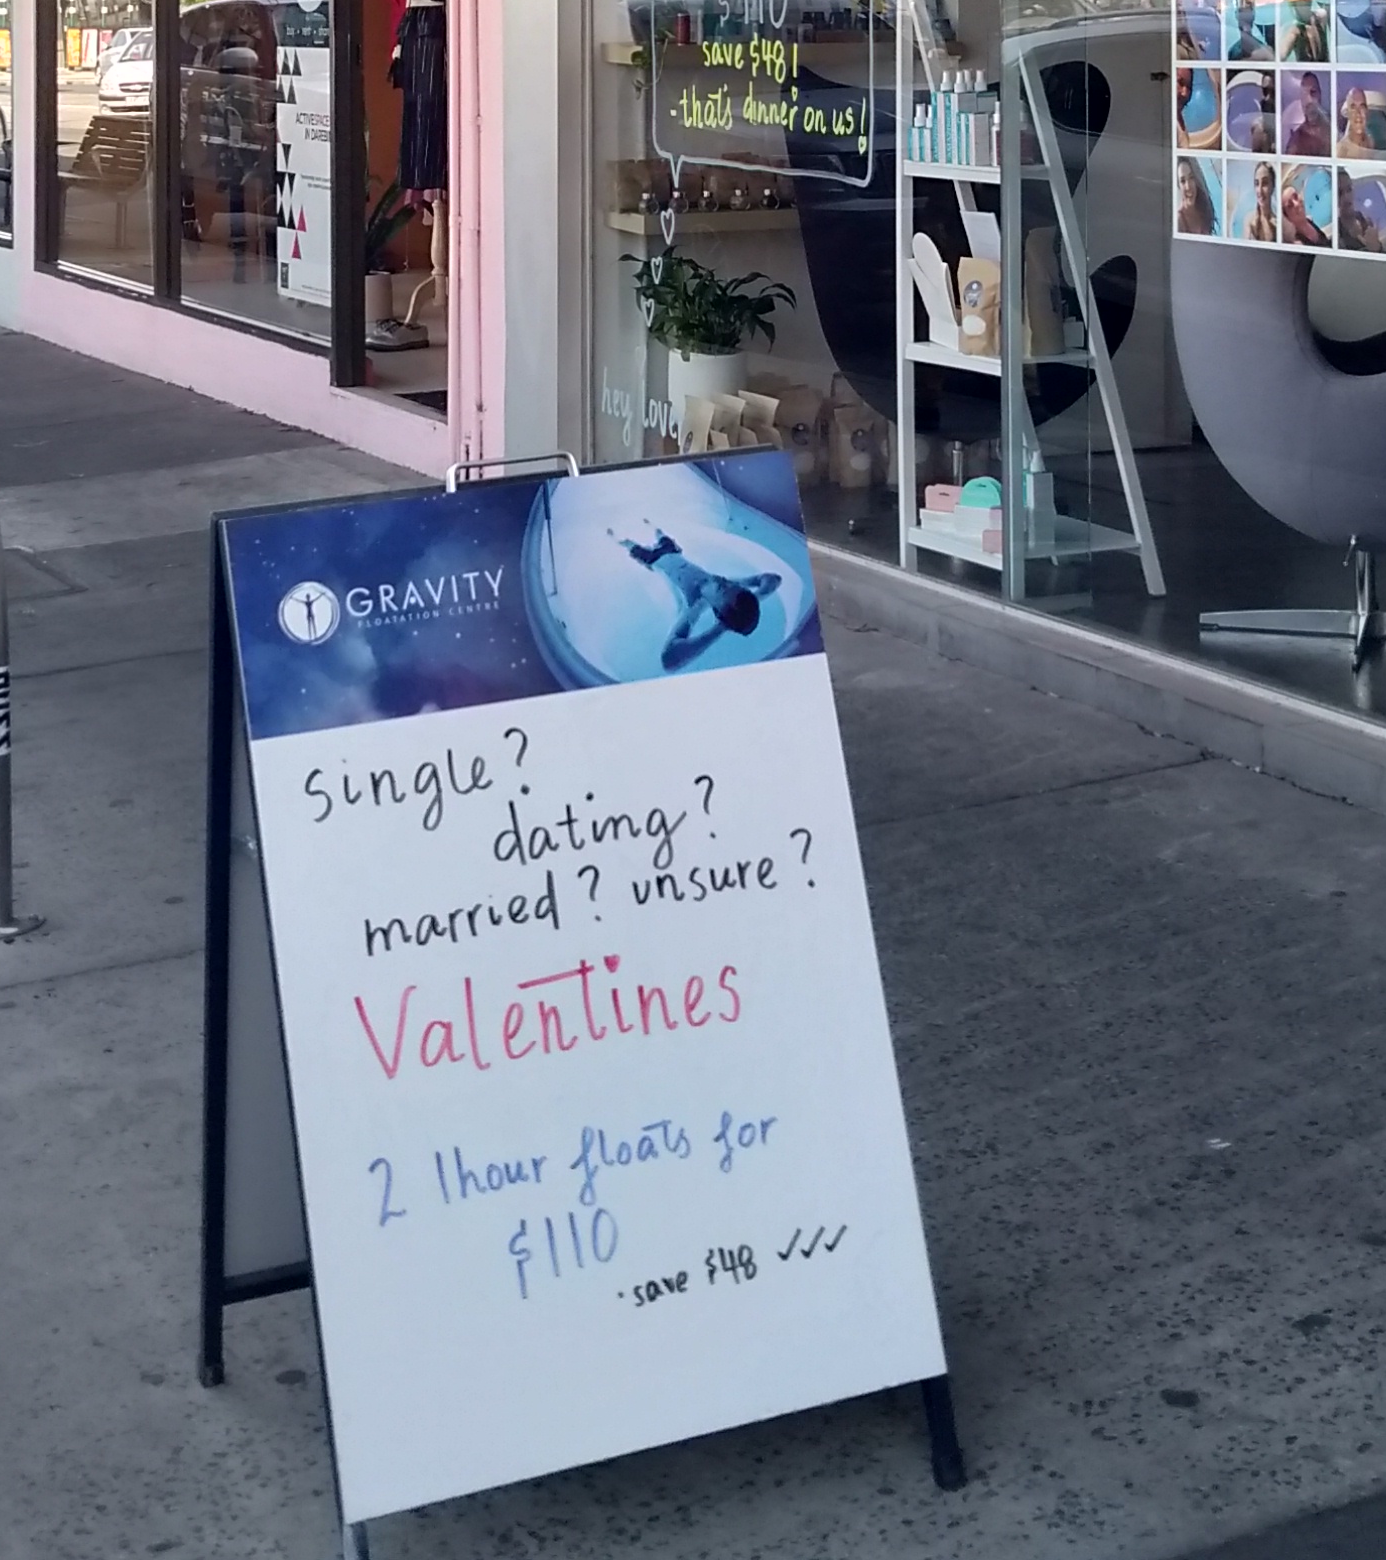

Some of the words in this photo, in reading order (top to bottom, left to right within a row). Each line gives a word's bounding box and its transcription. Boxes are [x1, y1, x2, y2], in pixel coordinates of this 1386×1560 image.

[701, 39, 744, 69] save
[742, 80, 799, 132] dinner
[803, 110, 826, 133] on
[600, 366, 632, 448] hey
[345, 568, 503, 617] GRAVITY
[357, 609, 441, 629] FLOATATION
[448, 600, 500, 616] CENTRE
[631, 827, 817, 907] unsure?
[353, 955, 742, 1080] Valentines
[367, 1156, 407, 1227] 2
[569, 1117, 693, 1207] floats
[713, 1110, 779, 1174] for
[508, 1206, 620, 1301] $110
[704, 1243, 758, 1286] $48
